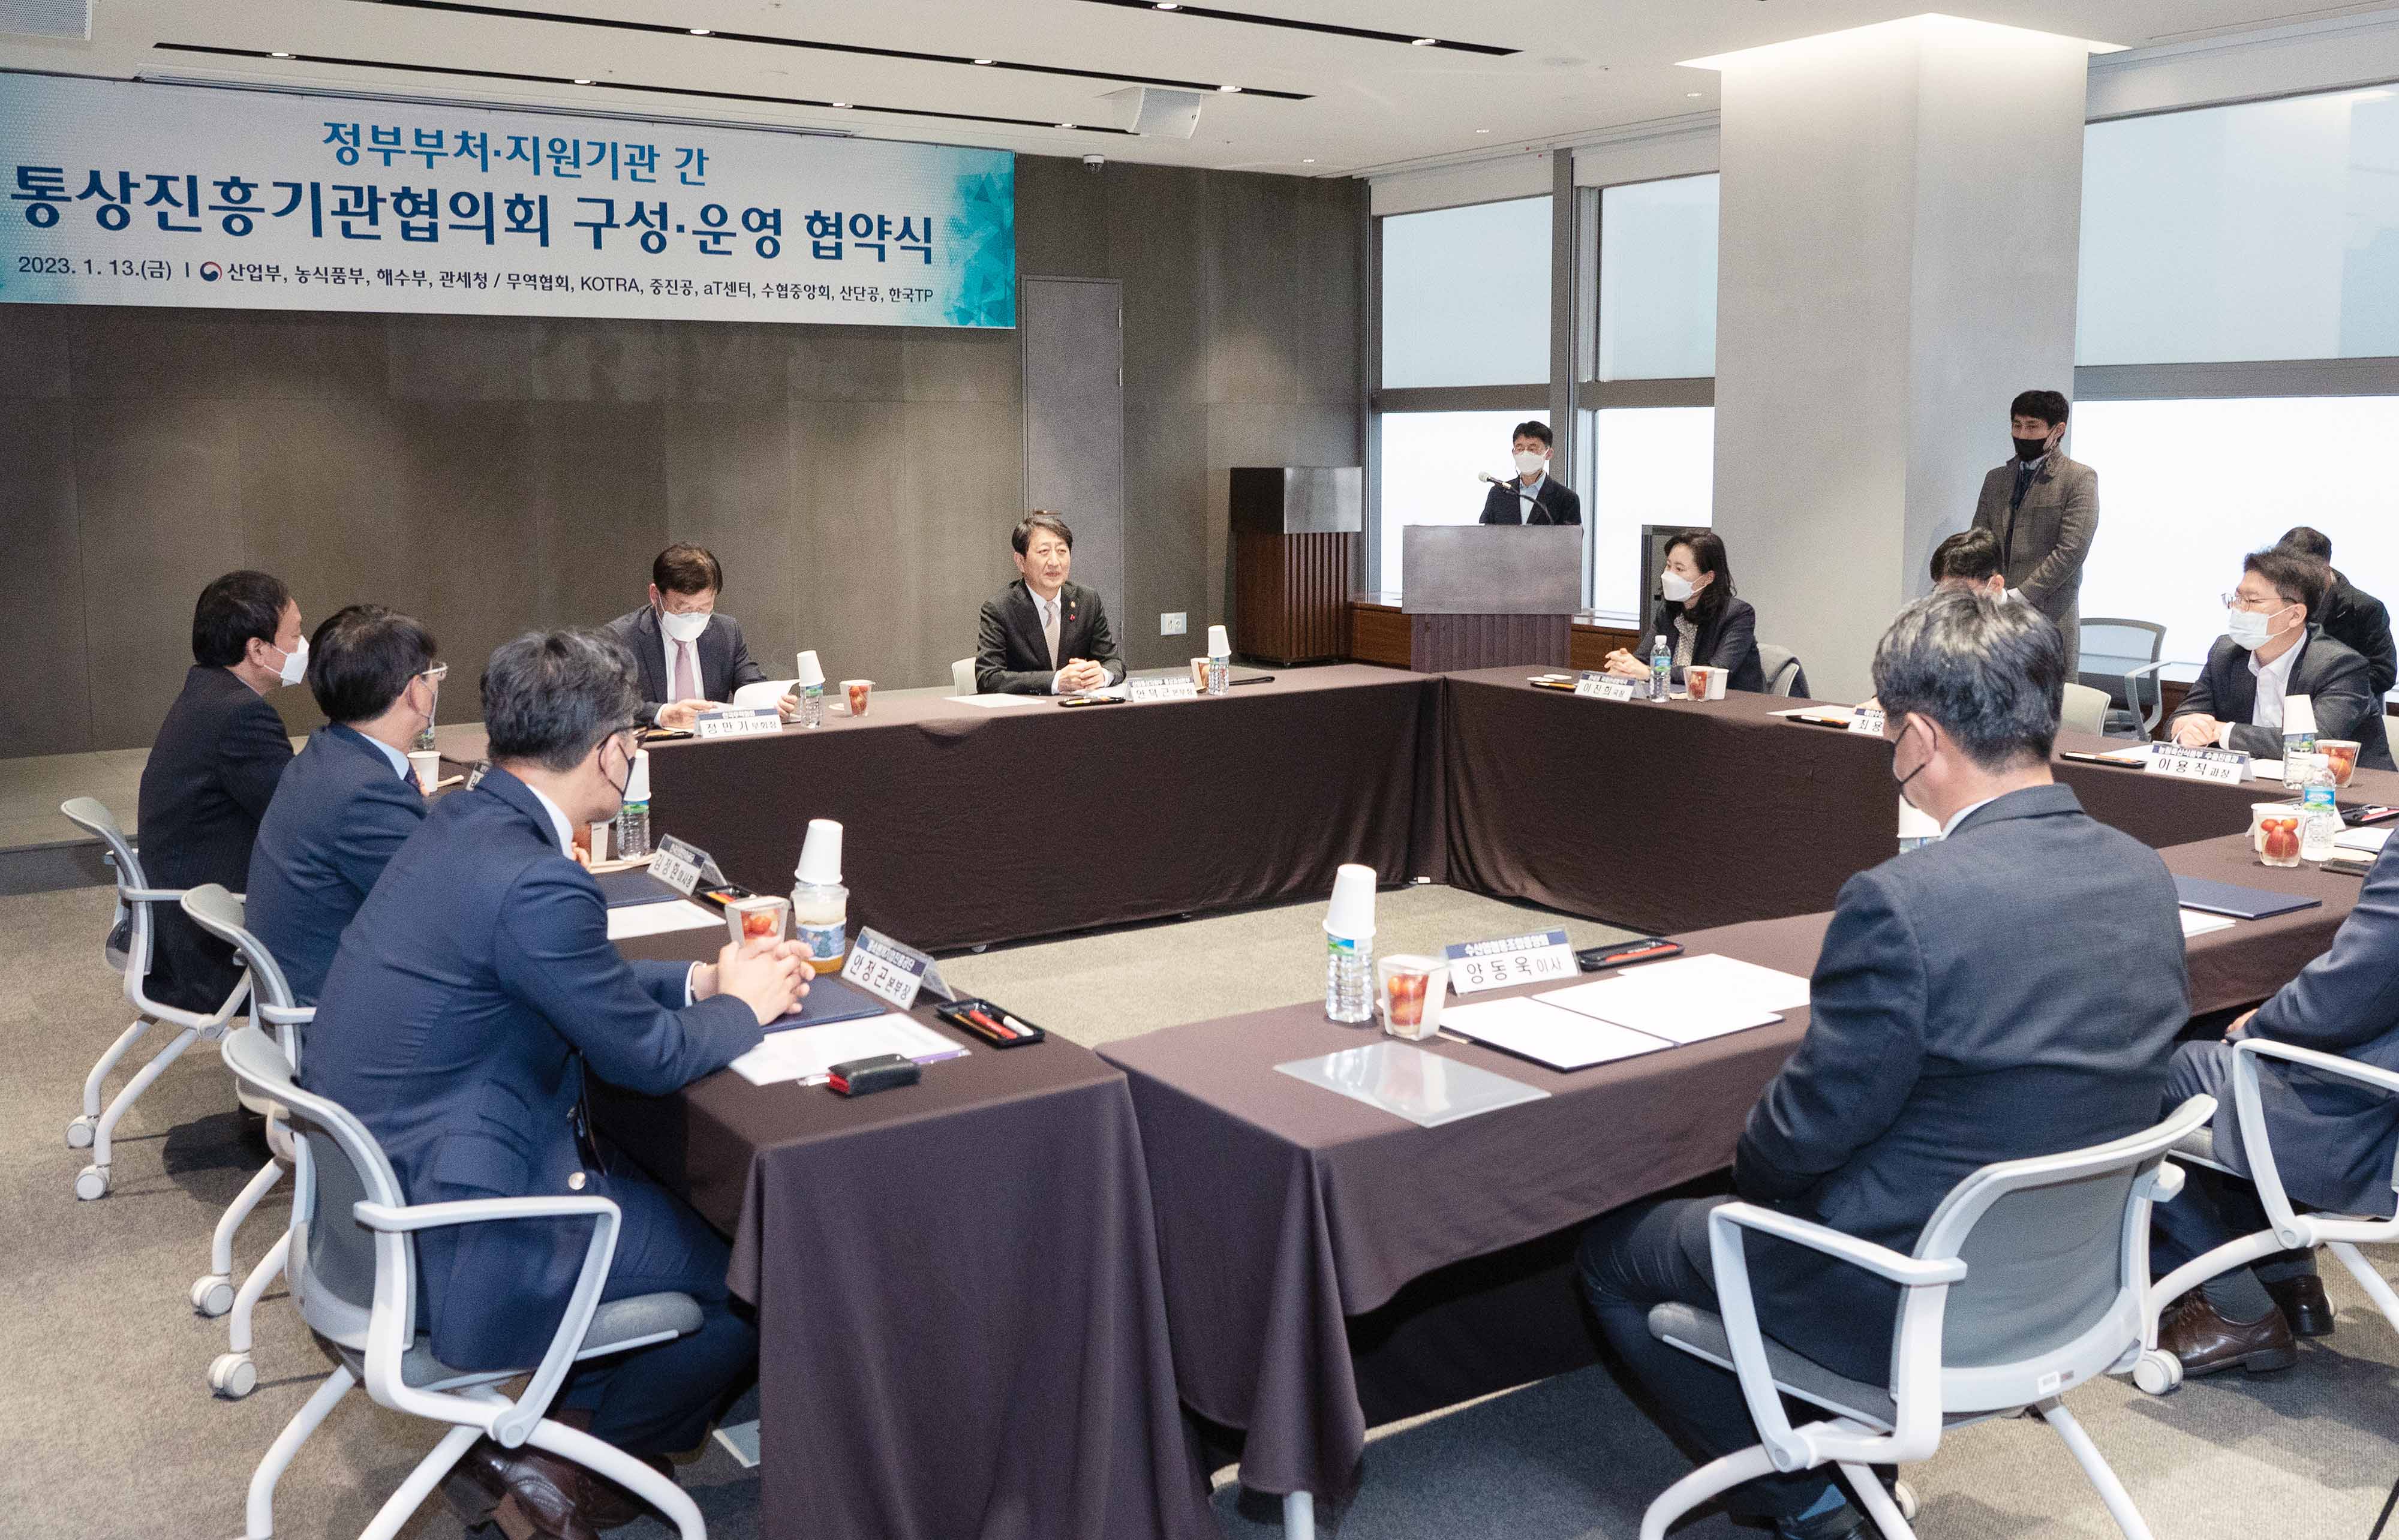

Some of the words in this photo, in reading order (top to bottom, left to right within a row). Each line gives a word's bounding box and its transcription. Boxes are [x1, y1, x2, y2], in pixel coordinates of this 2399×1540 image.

[322, 122, 661, 184] 정부부처·지원기관
[674, 148, 710, 187] 간
[10, 165, 551, 246] 통상진흥기관협의회
[575, 198, 781, 258] 구성·운영
[805, 210, 931, 264] 협약식
[18, 256, 76, 275] 2023.
[83, 258, 102, 275] 1.
[109, 260, 172, 281] 13.(금)
[227, 263, 287, 284] 산업부,
[294, 265, 370, 286] 농식품부,
[377, 269, 432, 288] 해수부,
[441, 272, 486, 288] 관세청
[506, 273, 575, 293] 무역협회,
[580, 276, 644, 294] KOTRA,
[650, 278, 699, 297] 중진공,
[704, 280, 756, 299] aT센터,
[761, 282, 835, 301] 수협중앙회,
[840, 285, 884, 303] 산단공,
[889, 287, 934, 303] 한국TP
[707, 720, 748, 735] 정만기
[2159, 757, 2208, 776] 이용직
[2209, 766, 2231, 778] 과장
[849, 954, 888, 989] 안정곤
[885, 977, 911, 1001] 본부장
[1466, 955, 1533, 984] 양동욱
[1536, 956, 1562, 974] 이사
